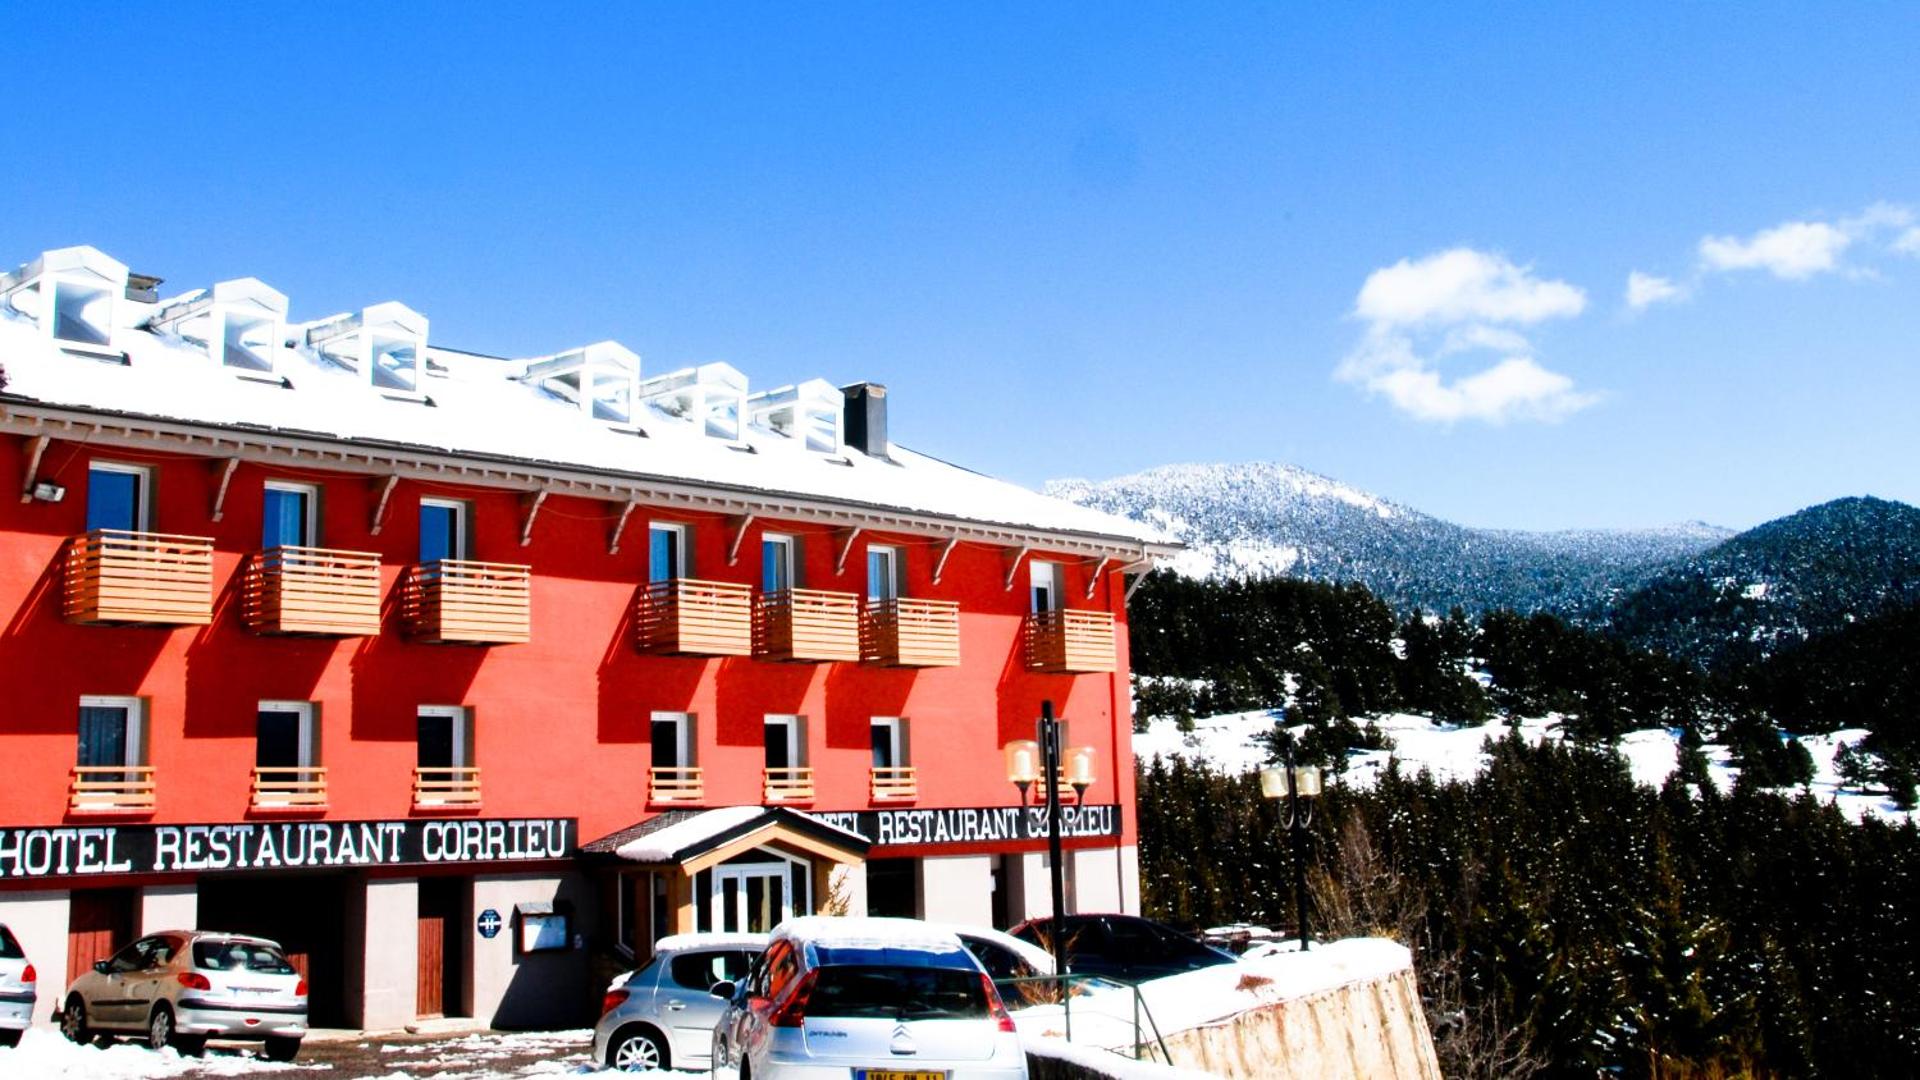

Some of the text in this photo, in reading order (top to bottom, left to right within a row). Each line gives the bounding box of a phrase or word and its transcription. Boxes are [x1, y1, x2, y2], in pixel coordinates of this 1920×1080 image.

[0, 820, 567, 876] HOTEL RESTAURANT CORRIEU
[877, 809, 1019, 844] RESTAURANT
[1027, 806, 1112, 838] CORIEU
